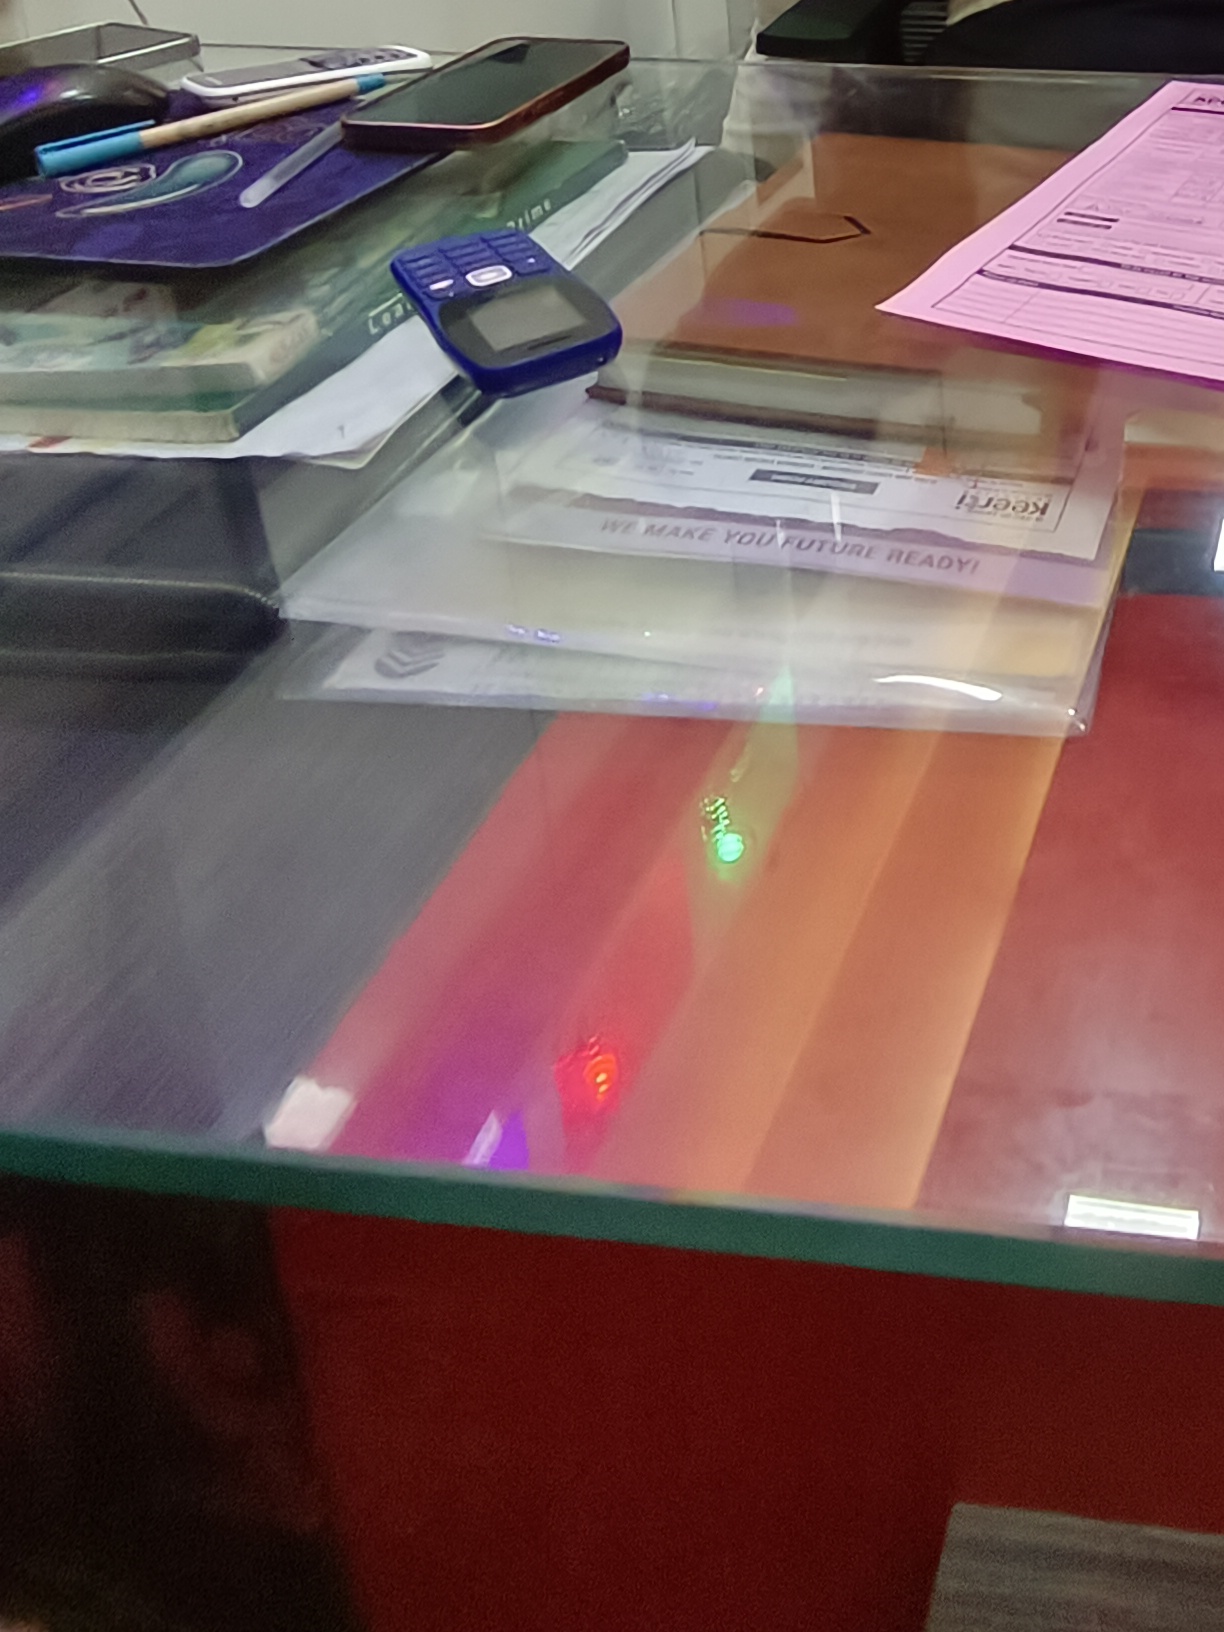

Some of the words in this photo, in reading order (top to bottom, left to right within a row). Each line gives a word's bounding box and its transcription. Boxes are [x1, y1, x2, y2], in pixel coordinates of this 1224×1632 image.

[643, 523, 715, 543] MAKE
[781, 536, 879, 561] FUTURE
[886, 549, 981, 576] READY!
